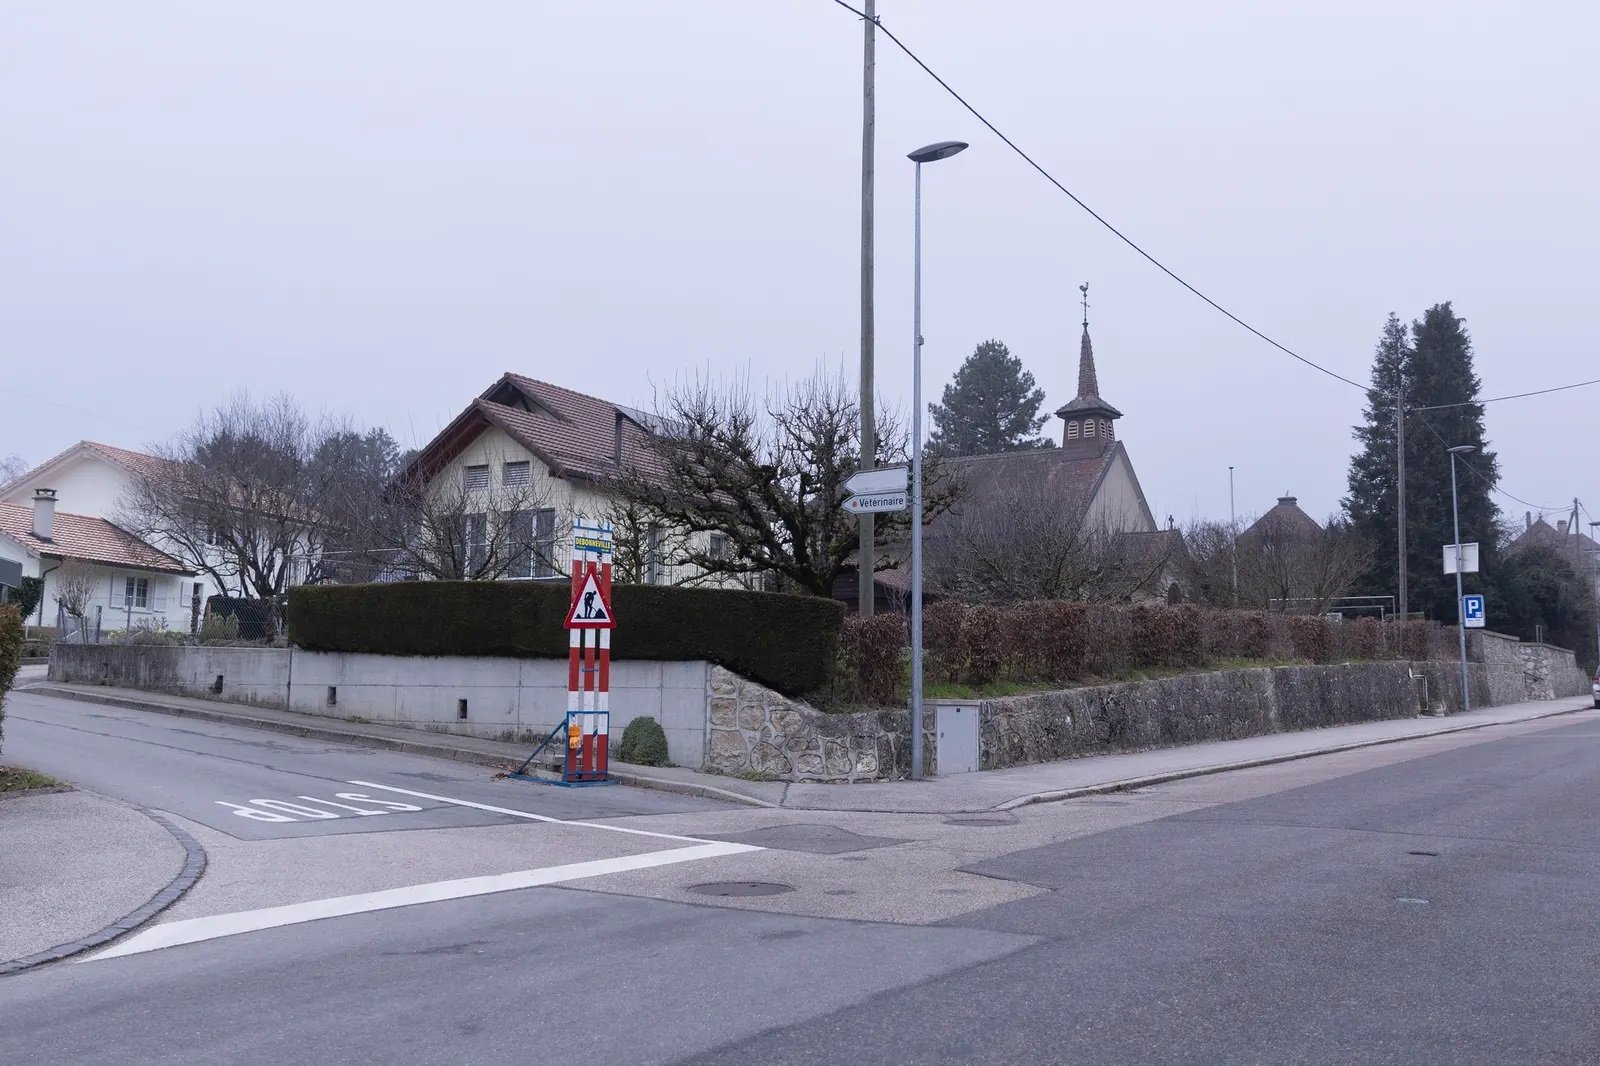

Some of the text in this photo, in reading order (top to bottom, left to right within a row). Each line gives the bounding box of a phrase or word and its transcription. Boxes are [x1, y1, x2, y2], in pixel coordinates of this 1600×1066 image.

[859, 497, 904, 508] Vétérinaire
[575, 537, 611, 549] DEBONNEVILLE
[1467, 599, 1479, 615] P
[214, 792, 423, 823] STOP
